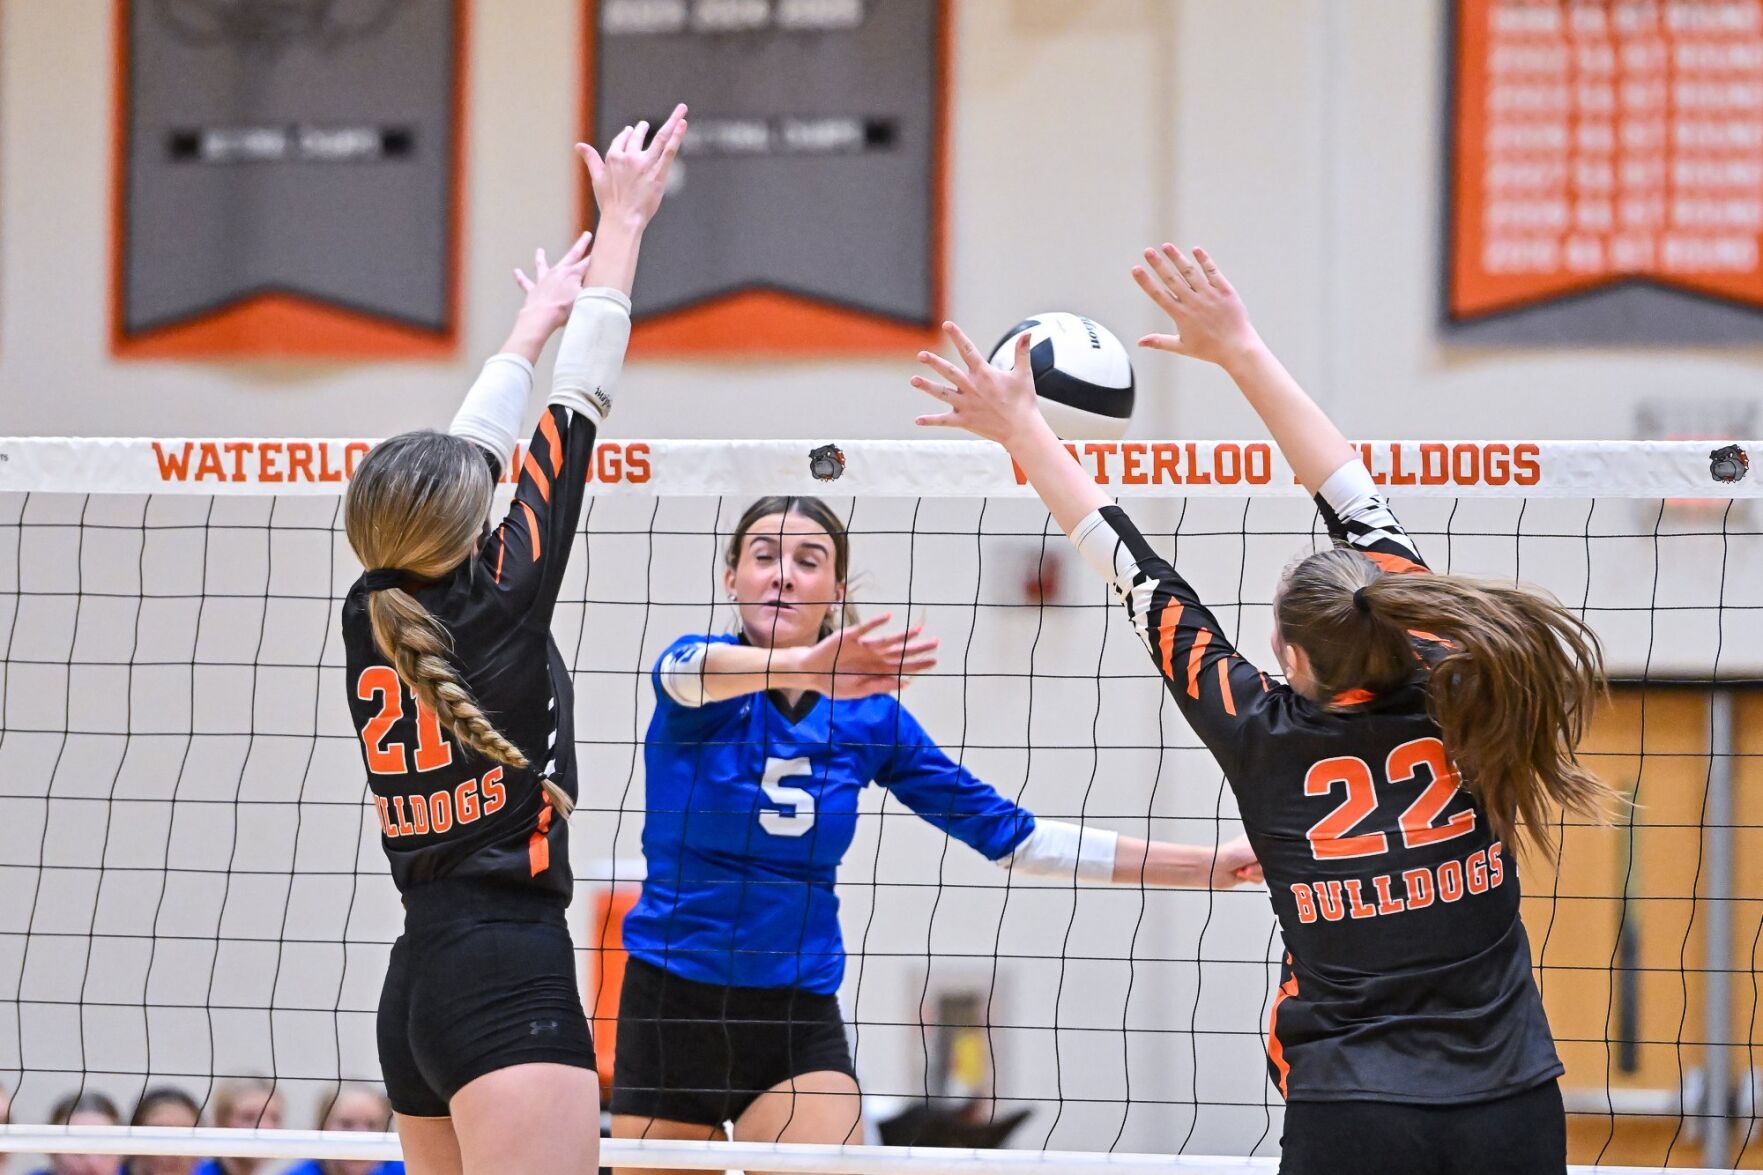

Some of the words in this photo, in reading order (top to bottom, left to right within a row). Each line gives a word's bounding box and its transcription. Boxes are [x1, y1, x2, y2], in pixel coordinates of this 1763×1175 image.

[151, 442, 371, 483] WATERLO
[1010, 443, 1271, 485] TERLOO
[1293, 443, 1541, 486] LLDOGS
[357, 665, 452, 775] 21
[373, 766, 506, 838] LLDOGS
[758, 756, 815, 837] 5
[1304, 737, 1477, 860] 22
[1290, 841, 1504, 924] BULLDOGS
